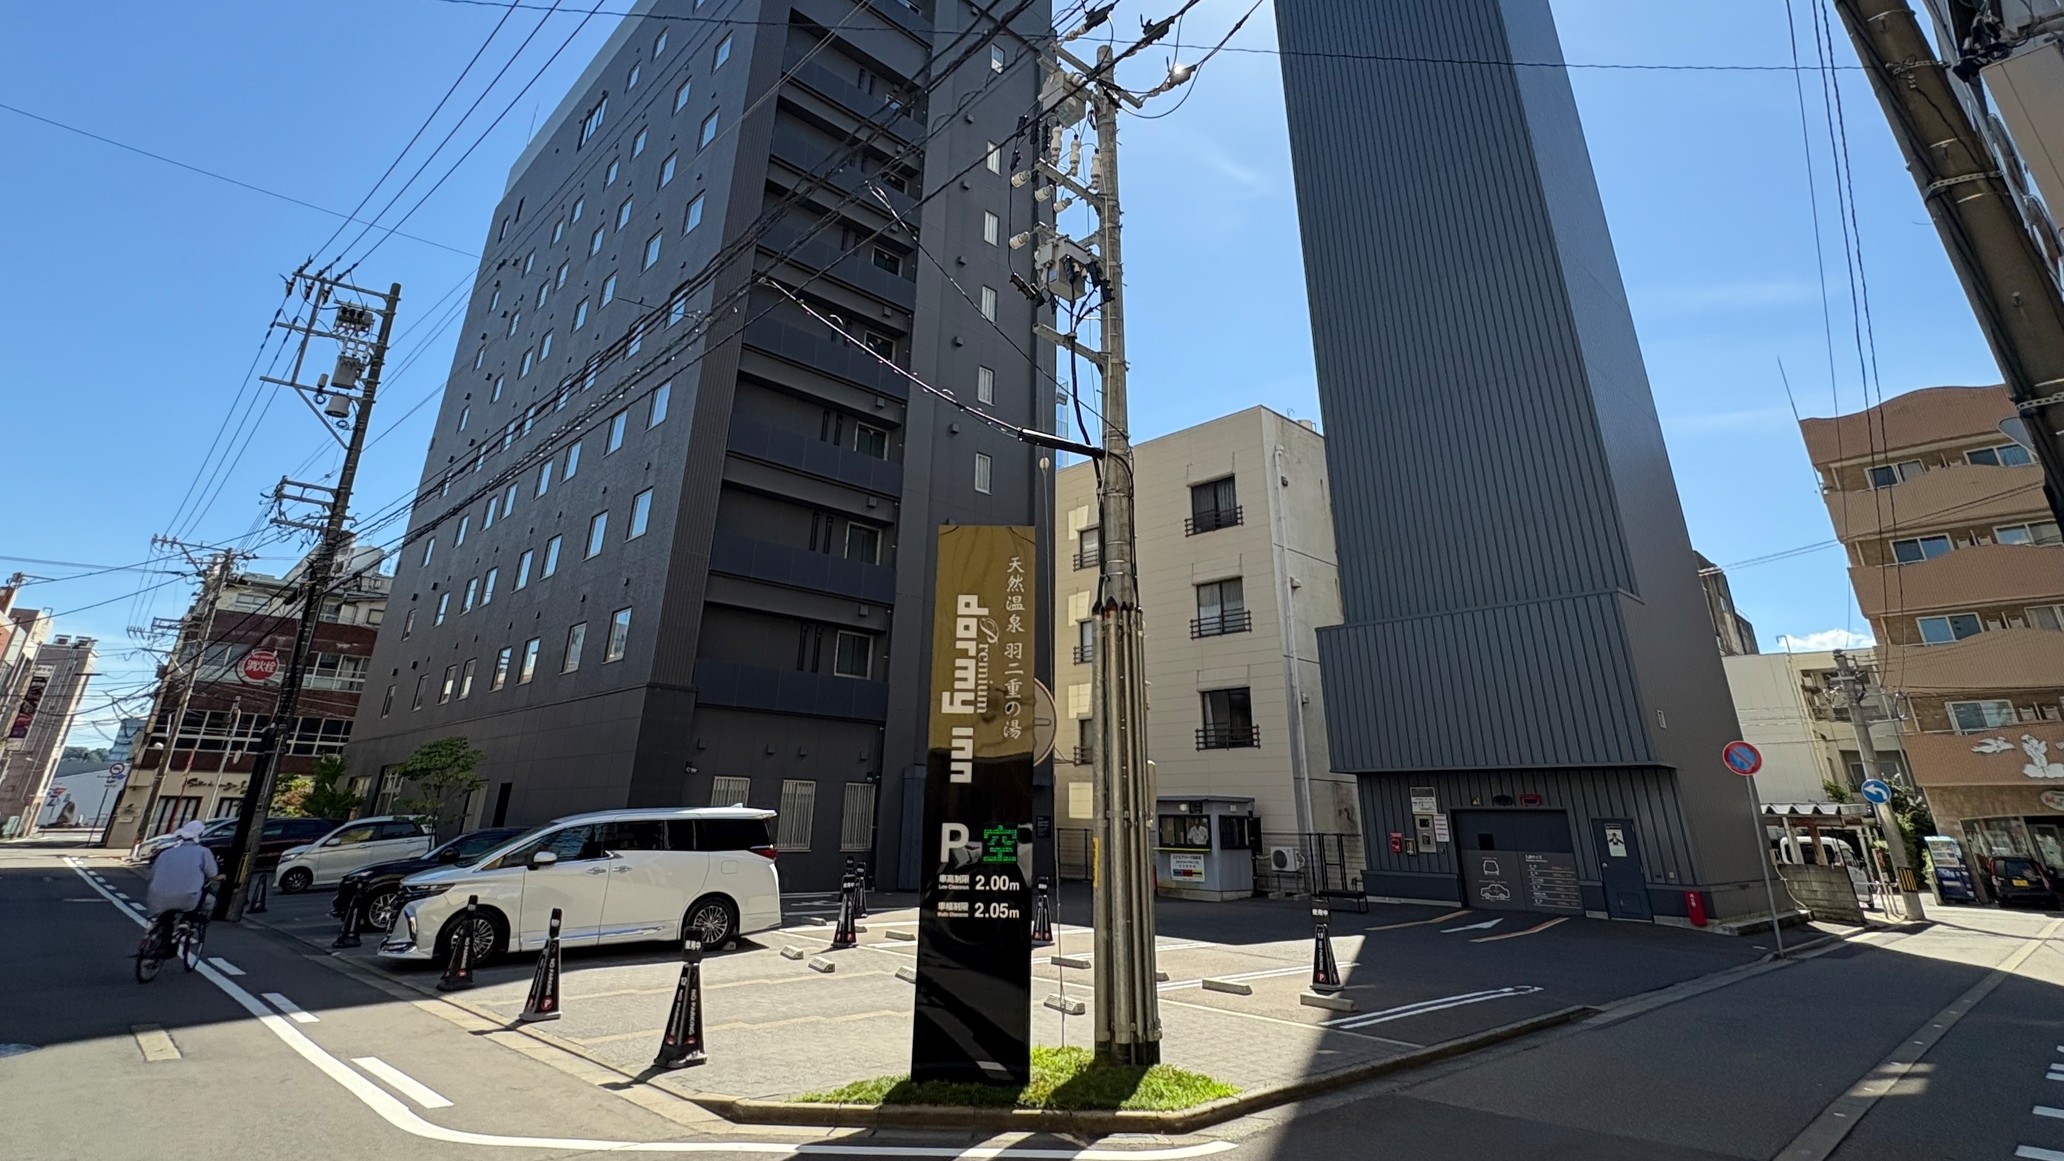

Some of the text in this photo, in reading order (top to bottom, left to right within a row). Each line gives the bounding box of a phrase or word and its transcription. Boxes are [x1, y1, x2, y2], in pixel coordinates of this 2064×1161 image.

[246, 659, 277, 673] 消火栓
[976, 617, 999, 714] Premium
[1003, 556, 1025, 740] 天然温泉 羽二重の湯
[941, 594, 989, 784] dormy inn
[940, 822, 970, 863] P
[983, 824, 1017, 862] 空
[975, 875, 1020, 891] 2.00m
[974, 902, 1020, 918] 2.05m
